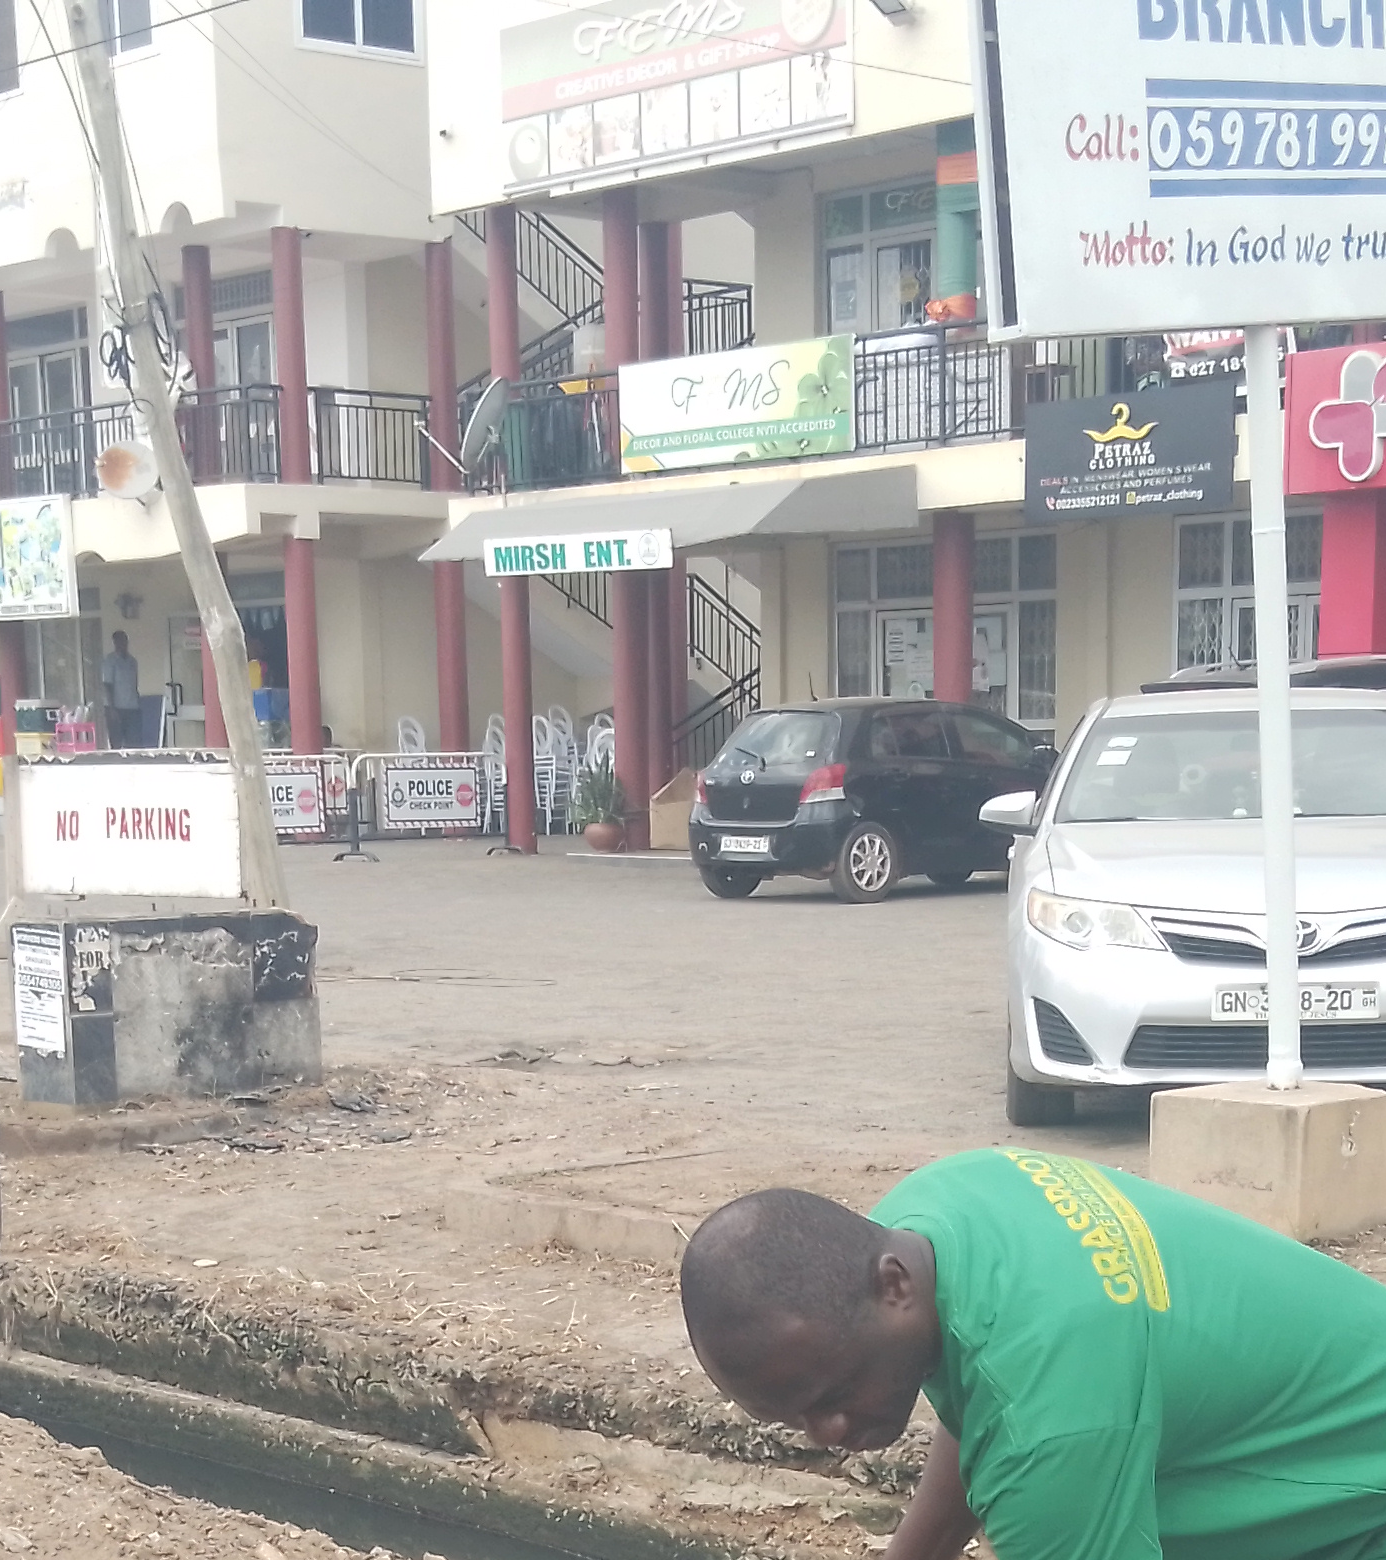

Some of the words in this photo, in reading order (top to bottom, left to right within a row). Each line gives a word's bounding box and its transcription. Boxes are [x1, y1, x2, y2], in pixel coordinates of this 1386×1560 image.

[1136, 0, 1385, 49] BRANCH
[555, 68, 624, 99] CREATIVE
[626, 56, 678, 85] DECOR
[698, 43, 733, 68] GIFT
[736, 32, 782, 58] SHOP
[1065, 112, 1140, 163] Call:
[1080, 220, 1175, 268] Motto:
[1186, 226, 1219, 267] In
[1228, 224, 1287, 264] God
[1296, 232, 1333, 267] we
[663, 436, 682, 447] AND
[683, 432, 714, 445] FLORAL
[716, 428, 754, 441] COLLEGE
[779, 419, 836, 435] ACCREDITED
[1094, 442, 1152, 460] PETRAZ
[1089, 455, 1156, 471] CLOTHING
[493, 543, 567, 573] MIRSH
[583, 538, 632, 568] ENT.
[271, 785, 294, 802] ICE
[408, 779, 453, 796] POLICE
[273, 807, 295, 817] POINT
[409, 801, 432, 810] CHECK
[434, 800, 454, 810] POINT
[56, 810, 80, 842] NO
[106, 807, 191, 842] PARKING
[79, 951, 104, 968] FOR
[1221, 991, 1247, 1013] GN
[1362, 997, 1376, 1007] GH
